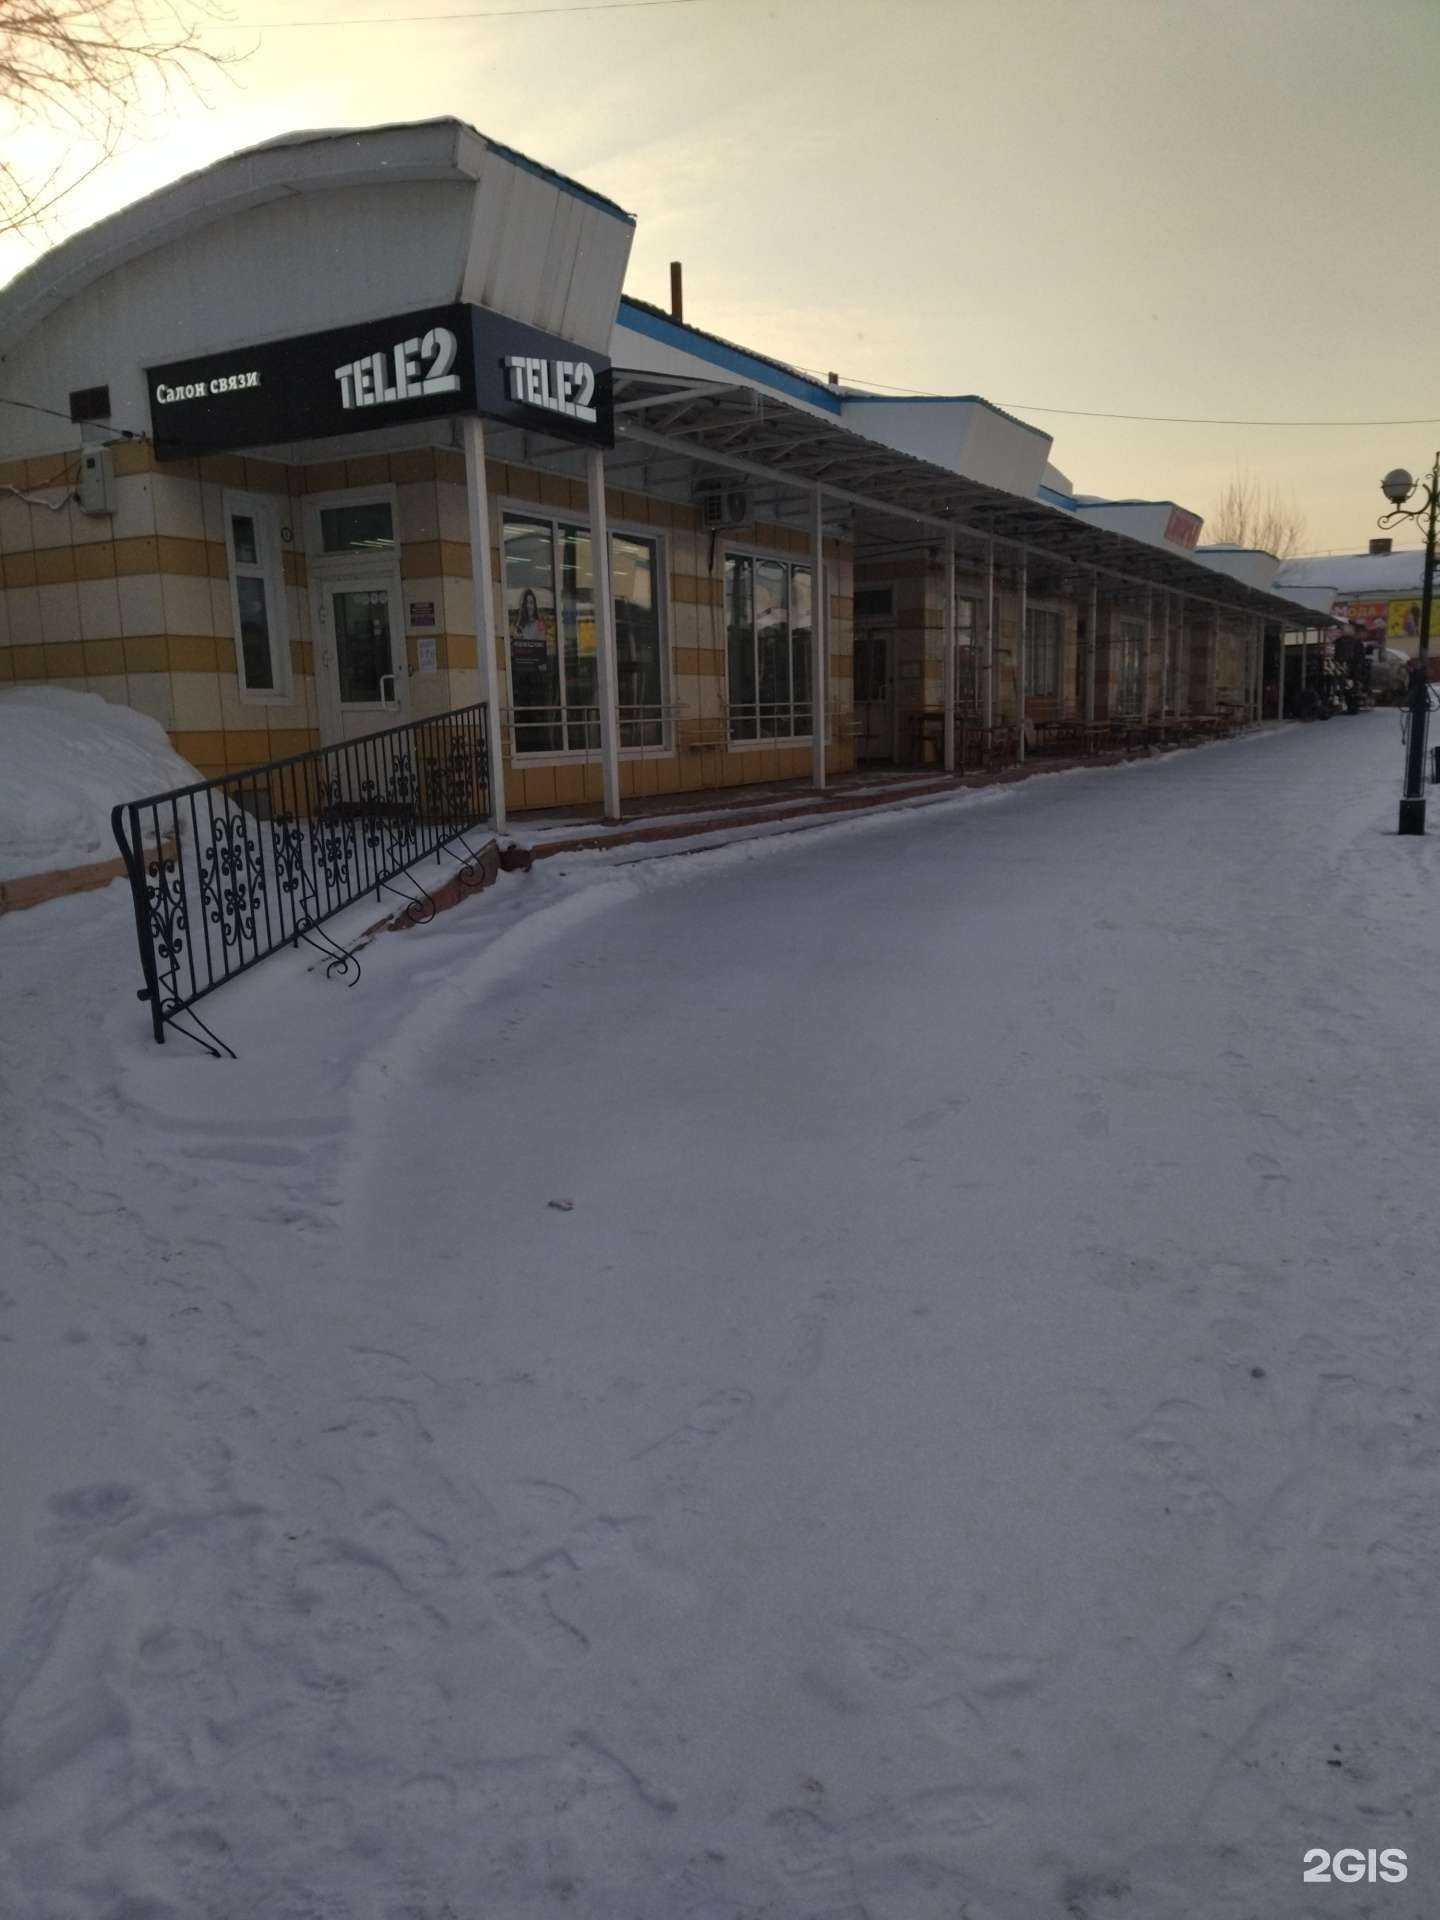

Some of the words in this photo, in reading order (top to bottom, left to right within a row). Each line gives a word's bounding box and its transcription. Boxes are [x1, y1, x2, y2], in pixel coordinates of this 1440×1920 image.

[156, 382, 206, 404] Салон
[210, 371, 260, 394] связи
[334, 327, 461, 410] TELE2
[504, 355, 597, 423] TELE2
